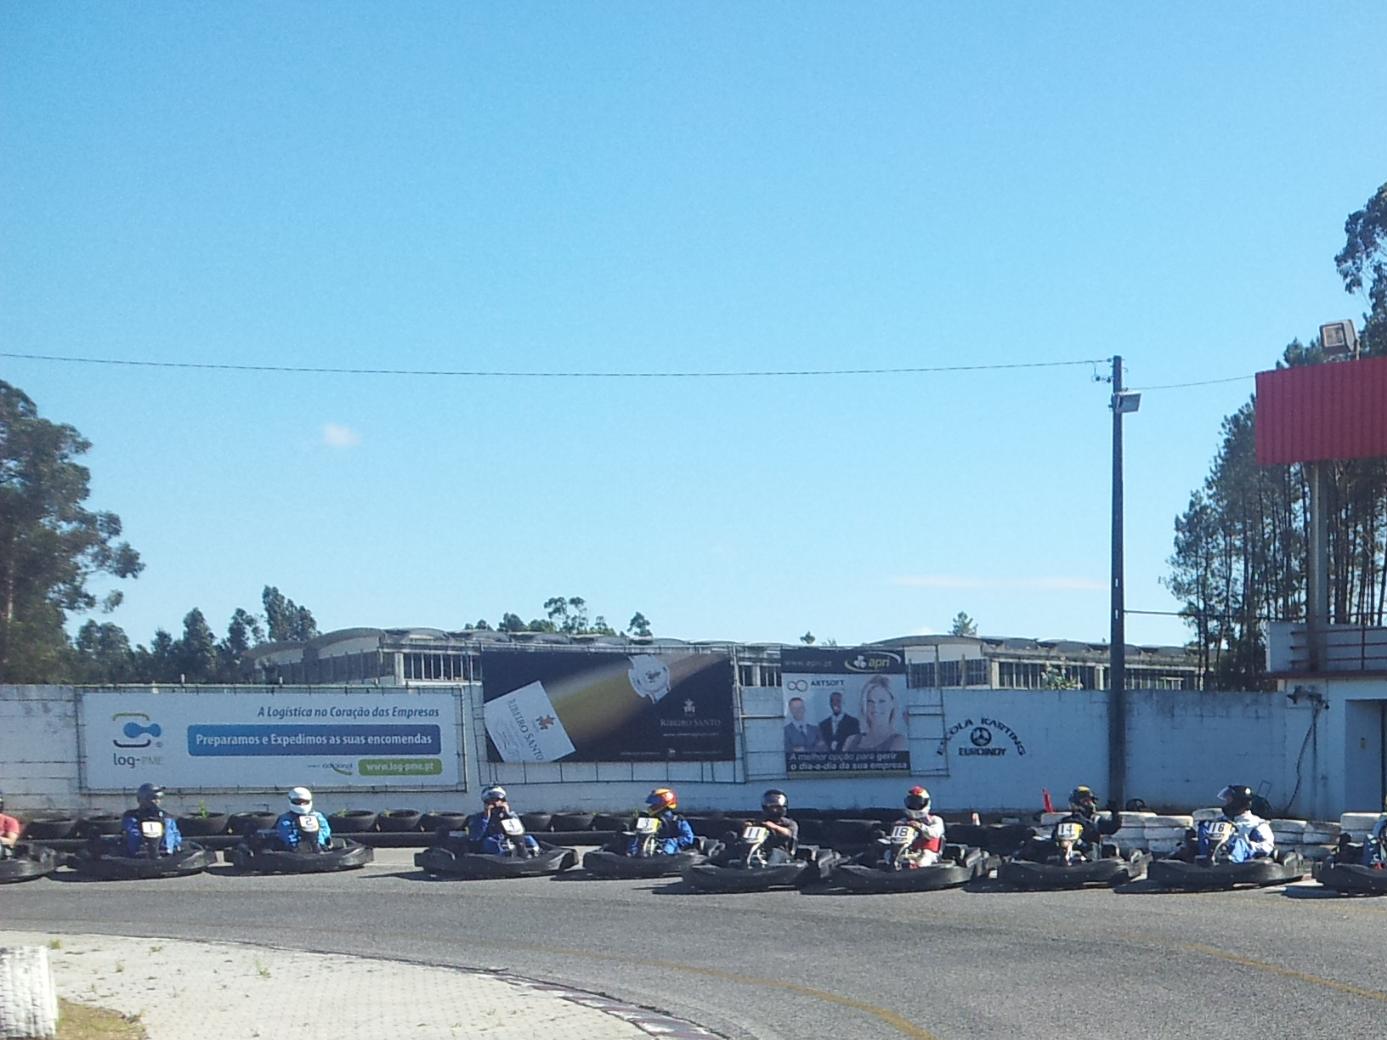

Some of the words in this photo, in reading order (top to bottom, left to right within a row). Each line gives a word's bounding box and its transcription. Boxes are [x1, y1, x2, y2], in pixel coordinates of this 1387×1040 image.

[257, 706, 265, 717] A
[267, 706, 312, 720] Logística
[314, 709, 327, 717] no
[329, 706, 370, 720] Coração
[371, 706, 390, 717] das
[392, 706, 440, 719] Empresas
[196, 733, 260, 748] Preparamos
[261, 736, 269, 745] e
[270, 733, 327, 748] Expedimos
[329, 734, 341, 745] as
[342, 734, 366, 745] suas
[367, 732, 433, 745] encomendas
[981, 717, 1026, 756] KARTING
[876, 752, 897, 761] gerir
[870, 762, 907, 772] empresa
[305, 816, 312, 826] 2
[894, 826, 909, 837] 18
[1061, 823, 1074, 834] 14
[1211, 823, 1225, 833] 16
